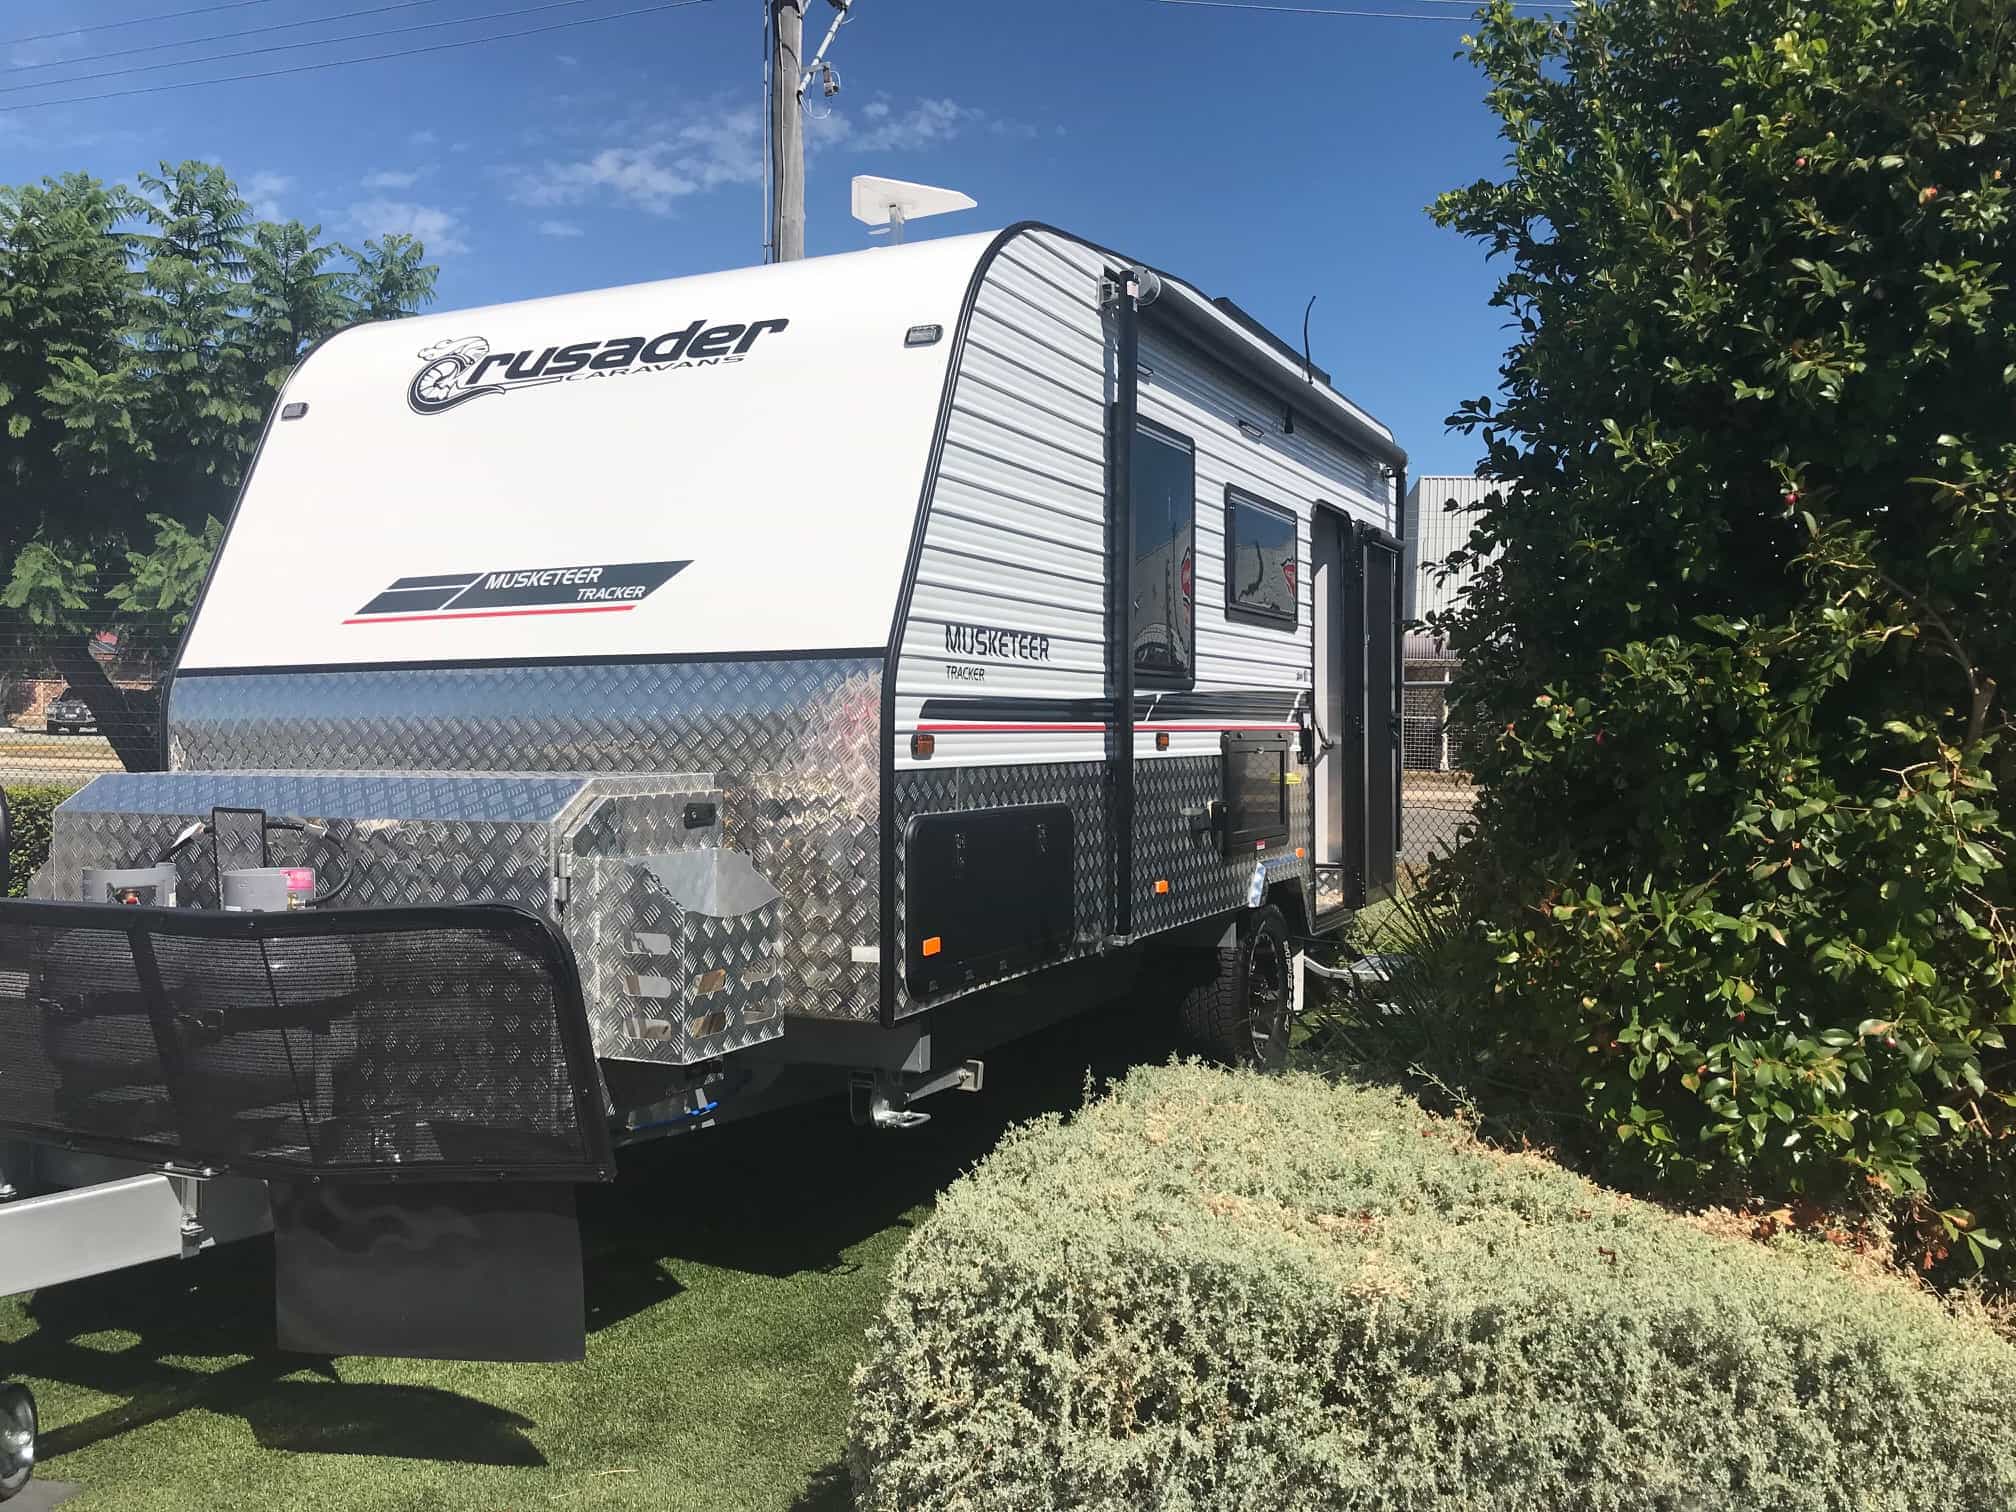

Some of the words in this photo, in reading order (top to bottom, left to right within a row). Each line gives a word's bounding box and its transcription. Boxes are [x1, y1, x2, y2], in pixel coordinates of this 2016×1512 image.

[565, 355, 744, 381] CARAVANS
[484, 567, 603, 590] MUSKETEER
[577, 586, 646, 600] TRACKER
[945, 625, 1050, 661] MUSKETEER
[945, 665, 985, 680] TRACKER
